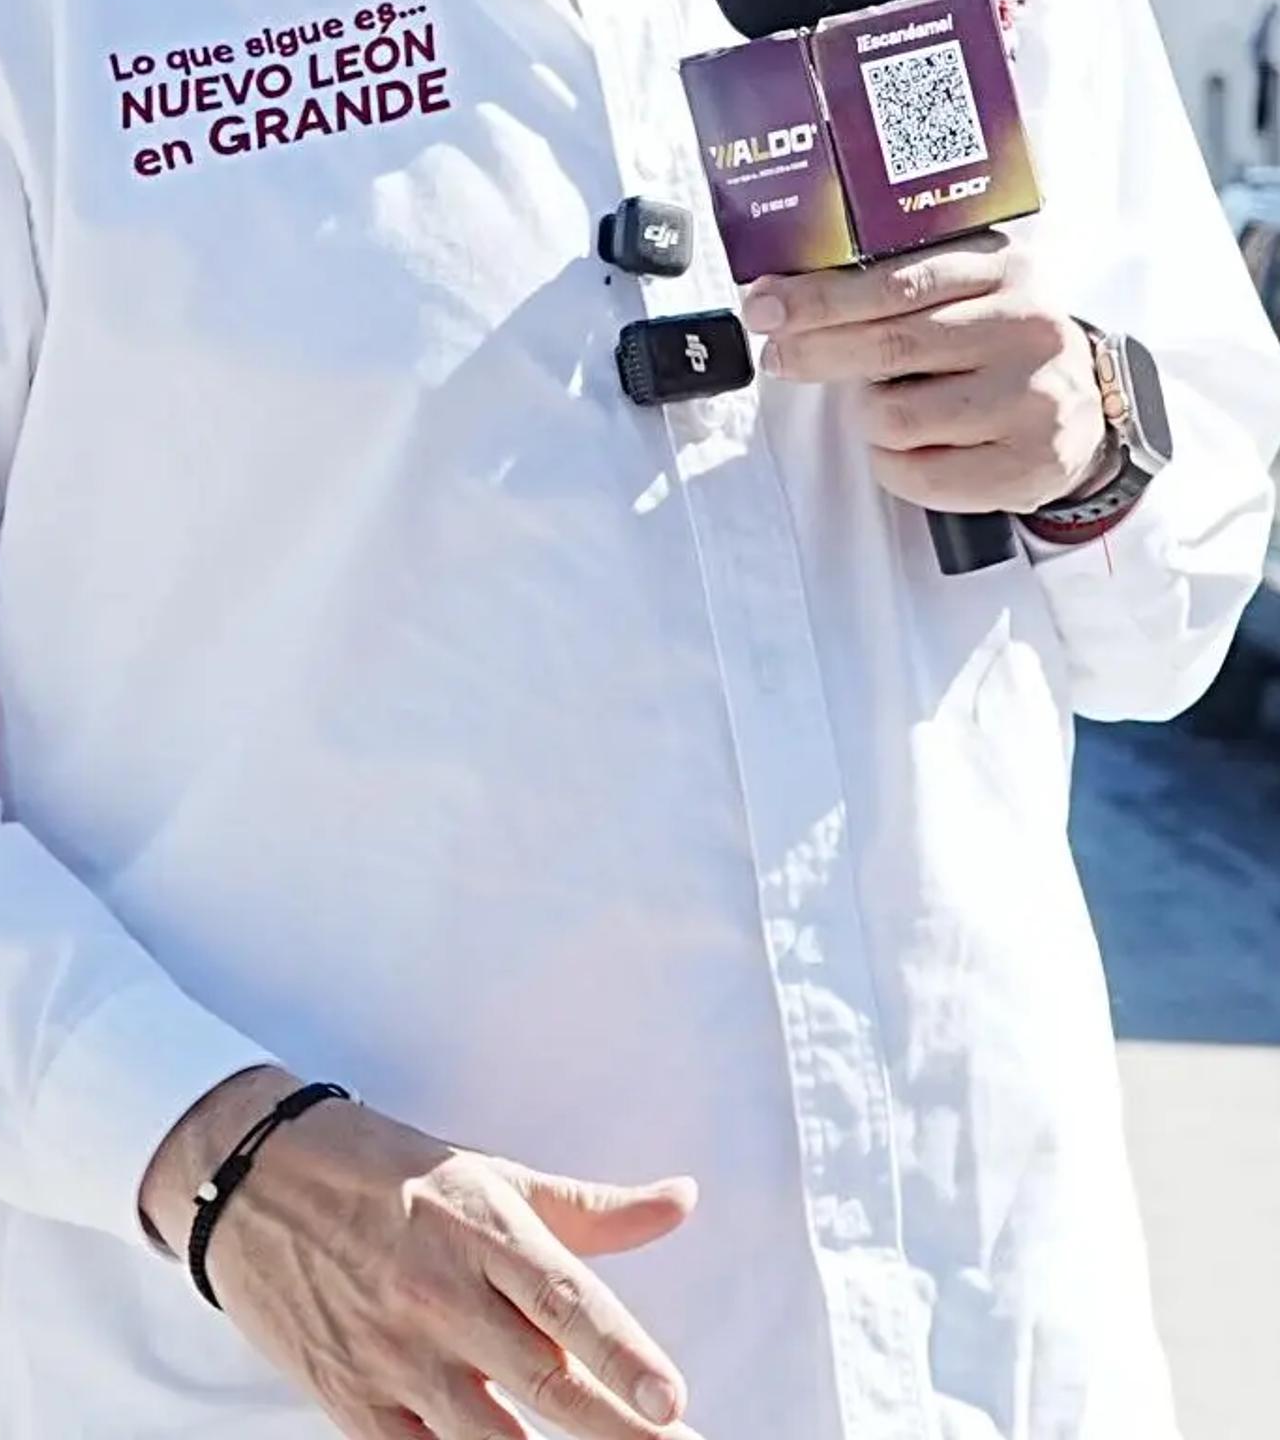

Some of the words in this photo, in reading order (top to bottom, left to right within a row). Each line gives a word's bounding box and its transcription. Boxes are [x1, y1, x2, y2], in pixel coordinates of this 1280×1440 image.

[110, 54, 155, 81] Lo
[167, 45, 235, 76] que
[245, 18, 344, 59] sigue
[121, 63, 293, 129] NUEVO
[309, 21, 436, 89] LEÓN
[134, 138, 194, 176] en
[209, 68, 451, 156] GRANDE
